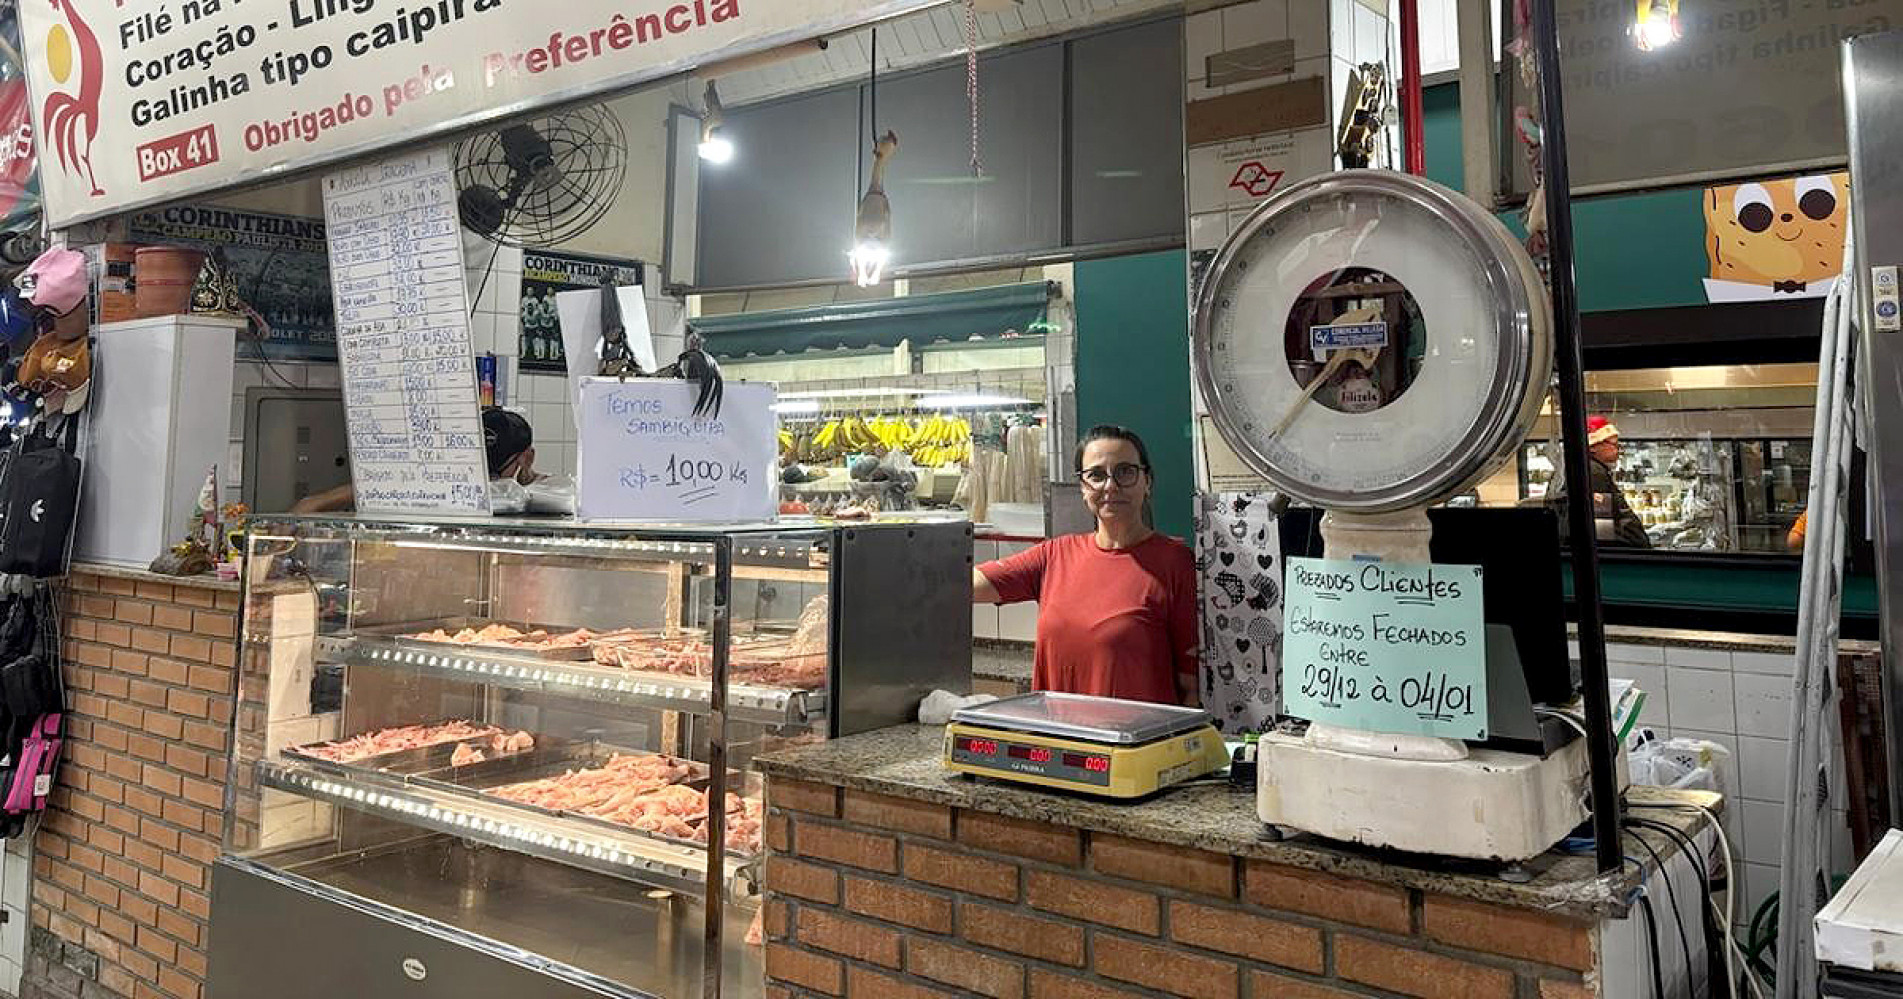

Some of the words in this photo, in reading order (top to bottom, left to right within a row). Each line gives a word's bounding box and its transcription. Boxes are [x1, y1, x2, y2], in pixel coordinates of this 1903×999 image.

[119, 10, 173, 49] Filé
[182, 0, 222, 25] na
[125, 22, 257, 88] Coração
[131, 71, 250, 127] Galinha
[260, 44, 333, 86] tipo
[141, 149, 182, 177] Box
[186, 133, 214, 164] 41
[244, 93, 373, 152] Obrigado
[383, 64, 454, 117] pela
[483, 0, 740, 88] Preferência
[164, 207, 326, 240] CORINTHIANS
[665, 453, 724, 488] 10,00
[1372, 613, 1467, 647] FECHADOS
[1301, 664, 1361, 704] 29/12
[1401, 671, 1475, 718] 04/01
